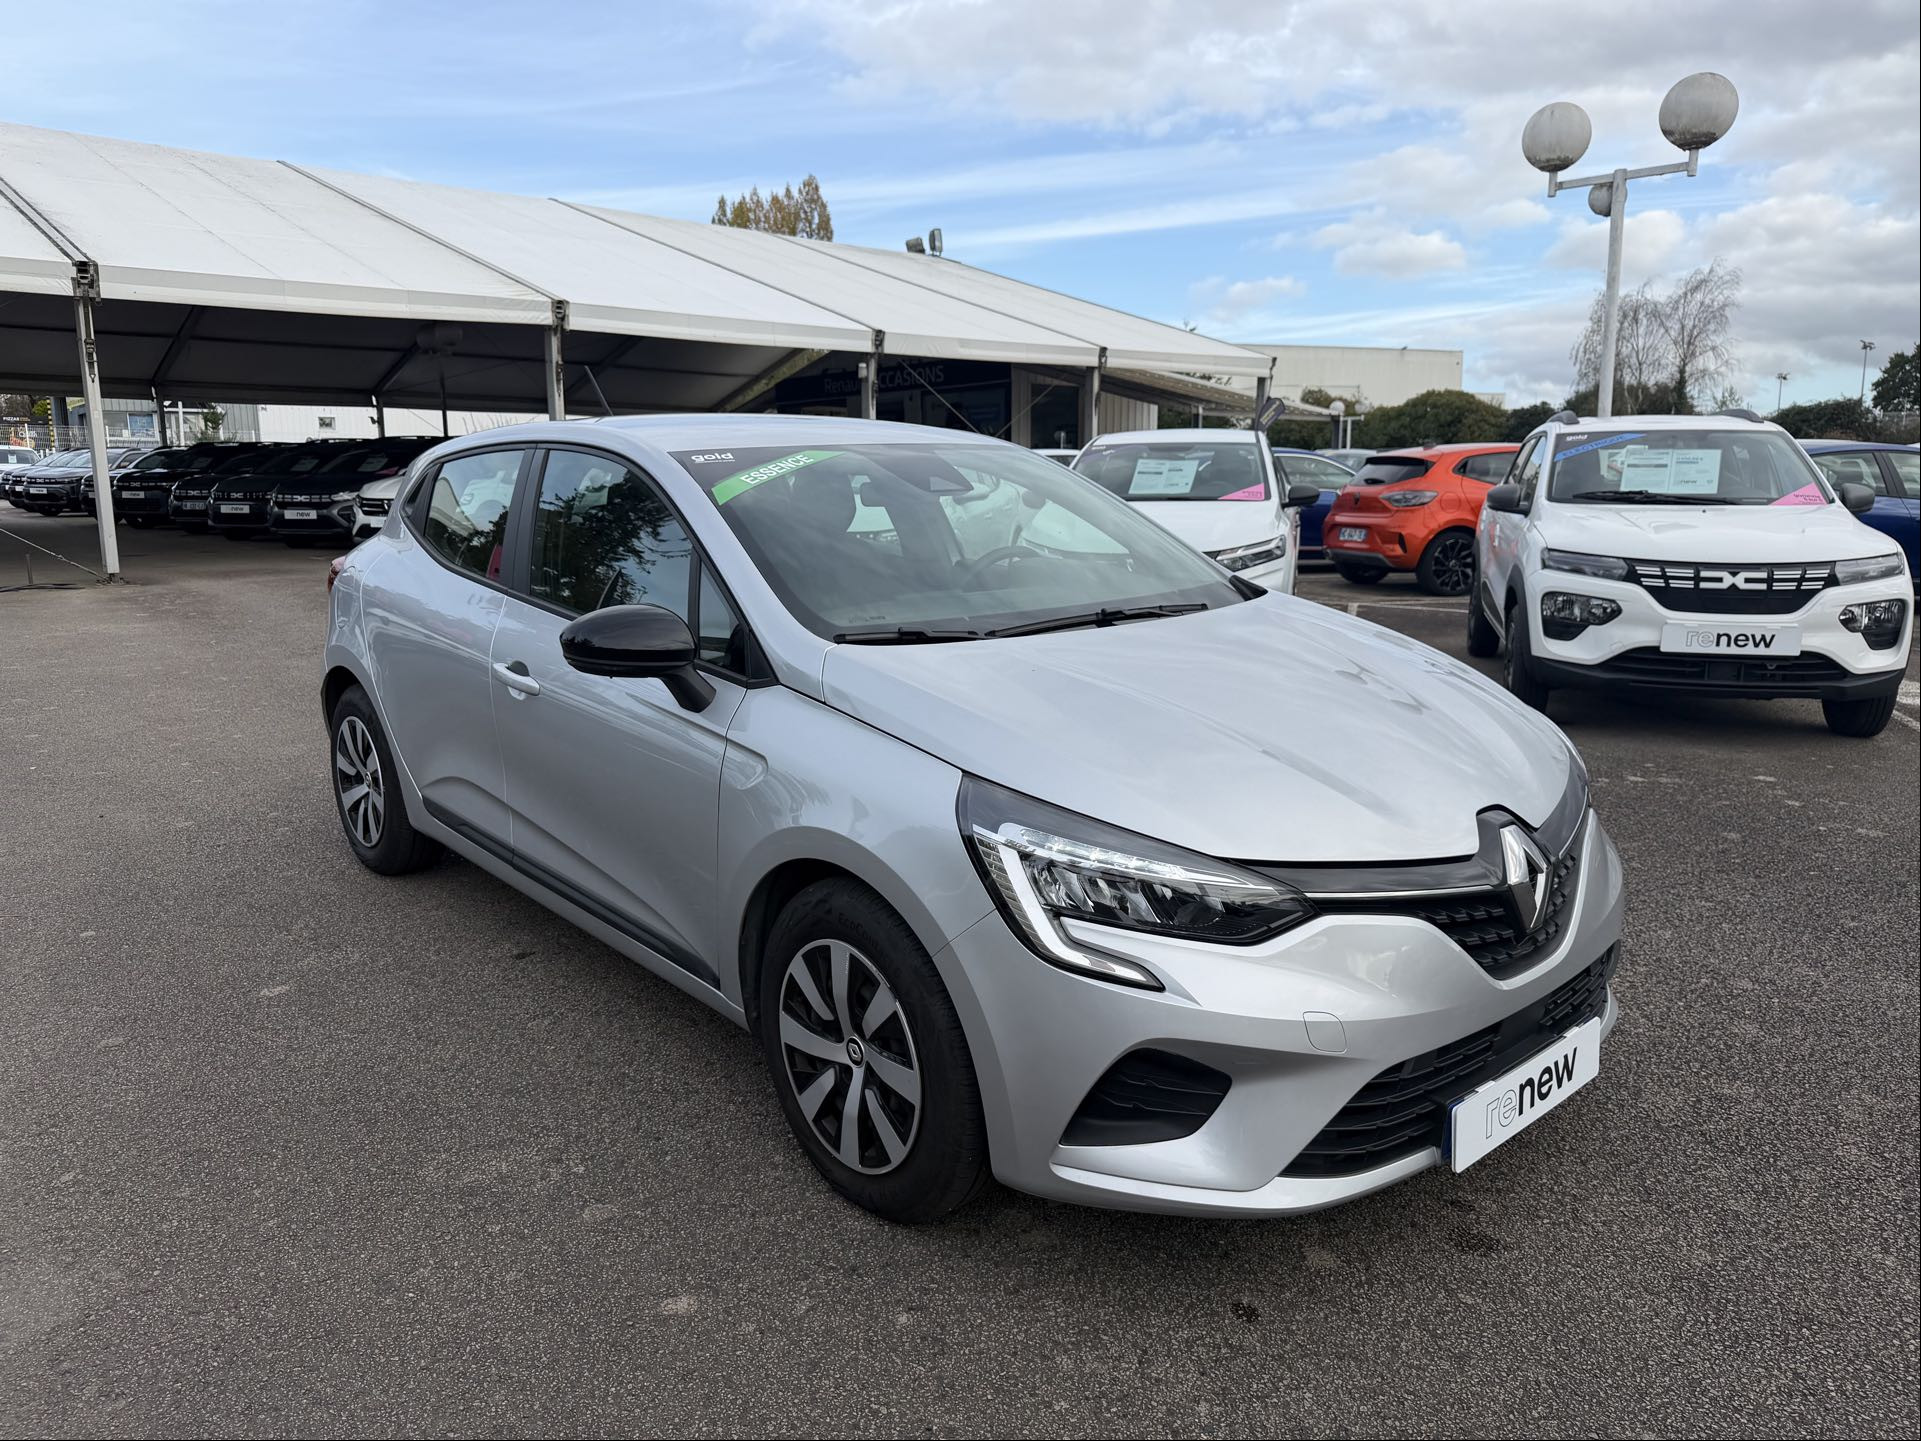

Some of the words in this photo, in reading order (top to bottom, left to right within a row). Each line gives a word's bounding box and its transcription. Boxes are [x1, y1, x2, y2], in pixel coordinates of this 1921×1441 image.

[878, 365, 944, 389] CCASIONS
[691, 452, 734, 463] gold
[739, 454, 814, 485] ESSENCE
[1685, 630, 1776, 649] renew
[1485, 1046, 1578, 1140] renew
